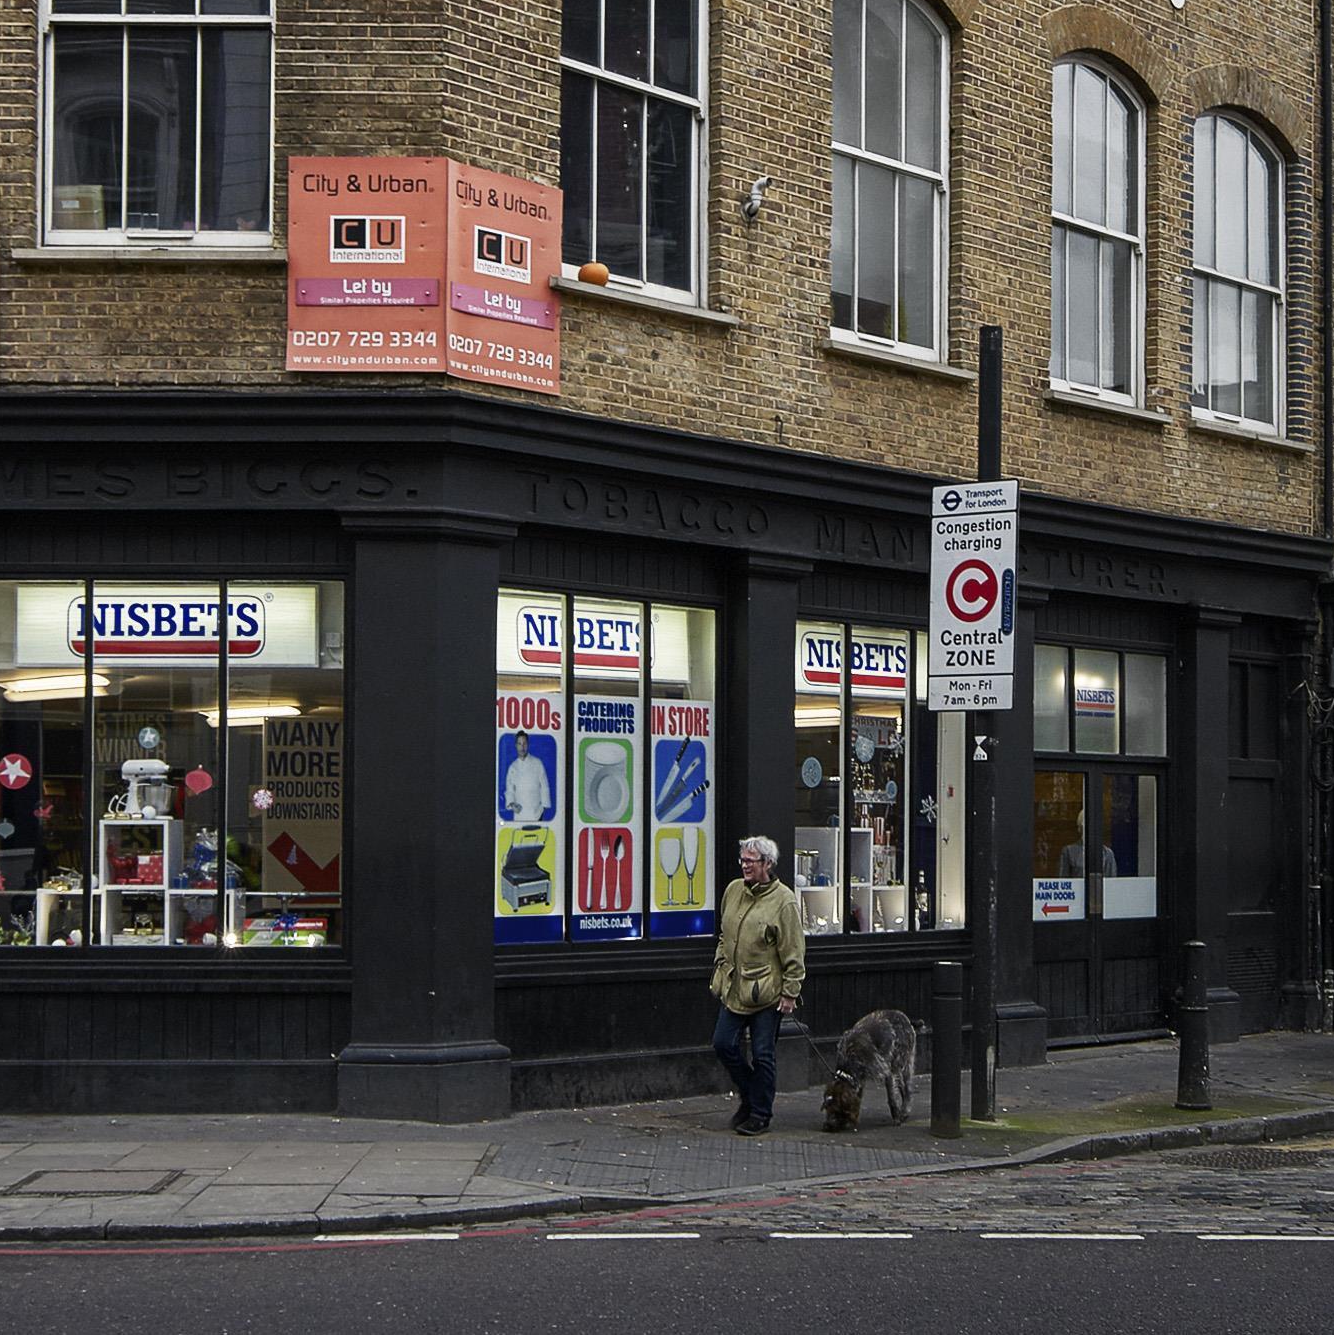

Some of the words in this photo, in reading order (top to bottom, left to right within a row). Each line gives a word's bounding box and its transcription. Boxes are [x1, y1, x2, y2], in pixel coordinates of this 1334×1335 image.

[303, 174, 338, 196] City
[346, 174, 362, 193] &
[456, 179, 482, 207] City
[487, 188, 499, 208] &
[332, 250, 403, 261] International
[342, 278, 367, 294] Let
[371, 278, 392, 297] by
[319, 296, 344, 305] Similar
[382, 296, 415, 305] Required
[484, 290, 503, 308] Let
[505, 294, 522, 315] by
[292, 331, 342, 347] 0207
[347, 331, 384, 347] 729
[389, 331, 437, 347] 3344
[292, 355, 438, 366] www.cityandurban.com
[449, 333, 483, 356] 0207
[487, 342, 514, 363] 729
[517, 348, 554, 371] 3344
[449, 360, 555, 388] www.cityandurban.com
[965, 489, 1003, 498] Transport
[520, 472, 769, 536] TOBACCO
[965, 500, 976, 509] for
[978, 498, 1007, 508] London
[936, 517, 1012, 536] Congestion
[944, 535, 1002, 552] charging
[76, 602, 259, 637] NISBETS
[523, 613, 642, 652] NIBET
[940, 627, 1003, 646] Central
[945, 649, 996, 667] ZONE
[949, 680, 971, 691] Mon
[978, 679, 992, 691] Fri
[1076, 689, 1115, 704] NISBETS
[496, 696, 561, 731] 1000s
[578, 700, 635, 718] CATERING
[577, 716, 635, 734] PRODUCTS
[651, 705, 665, 735] IN
[668, 705, 710, 737] STORE
[267, 721, 340, 747] MANY
[267, 751, 340, 777] MORE
[267, 781, 340, 798] PRODUCTS
[267, 802, 340, 820] DOWNSTAIRS
[1038, 881, 1060, 890] PLEASE
[1061, 881, 1072, 890] USE
[1035, 891, 1052, 900] MAIN
[1053, 891, 1075, 900] DOORS
[579, 915, 633, 930] nisbets.co.uk
